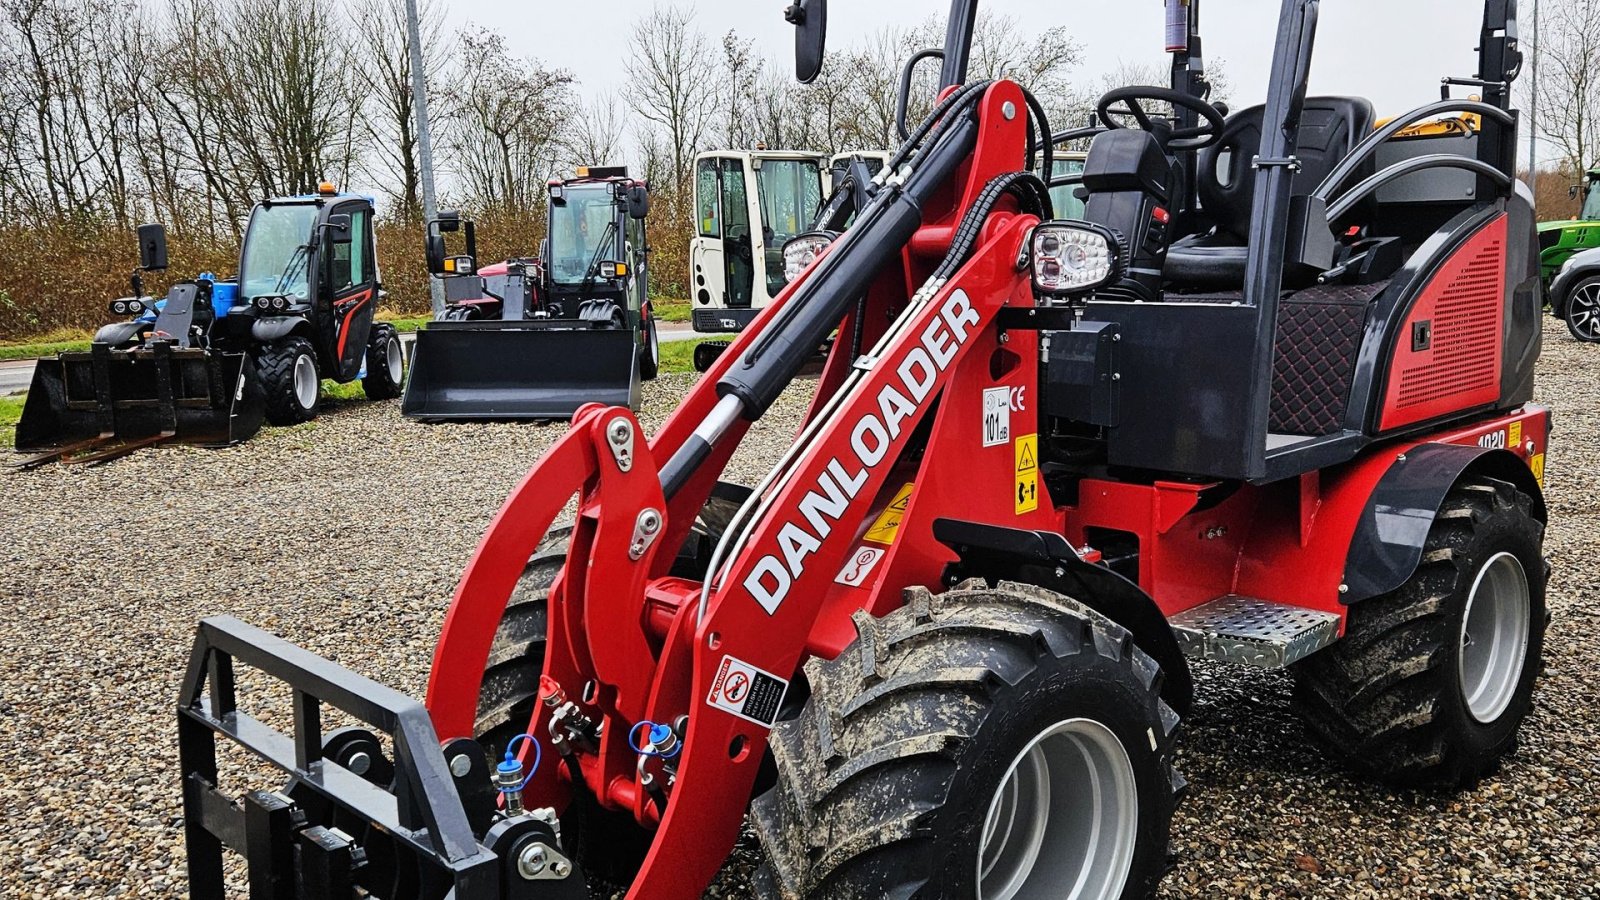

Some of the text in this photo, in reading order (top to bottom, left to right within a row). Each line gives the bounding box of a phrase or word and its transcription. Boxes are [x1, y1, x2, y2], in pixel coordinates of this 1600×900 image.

[815, 203, 835, 231] EREX
[1009, 385, 1026, 412] CE
[743, 288, 980, 615] DANLOADER
[1478, 429, 1505, 449] 1020
[716, 663, 729, 688] DANGER
[745, 676, 763, 714] CRUSH RISK
